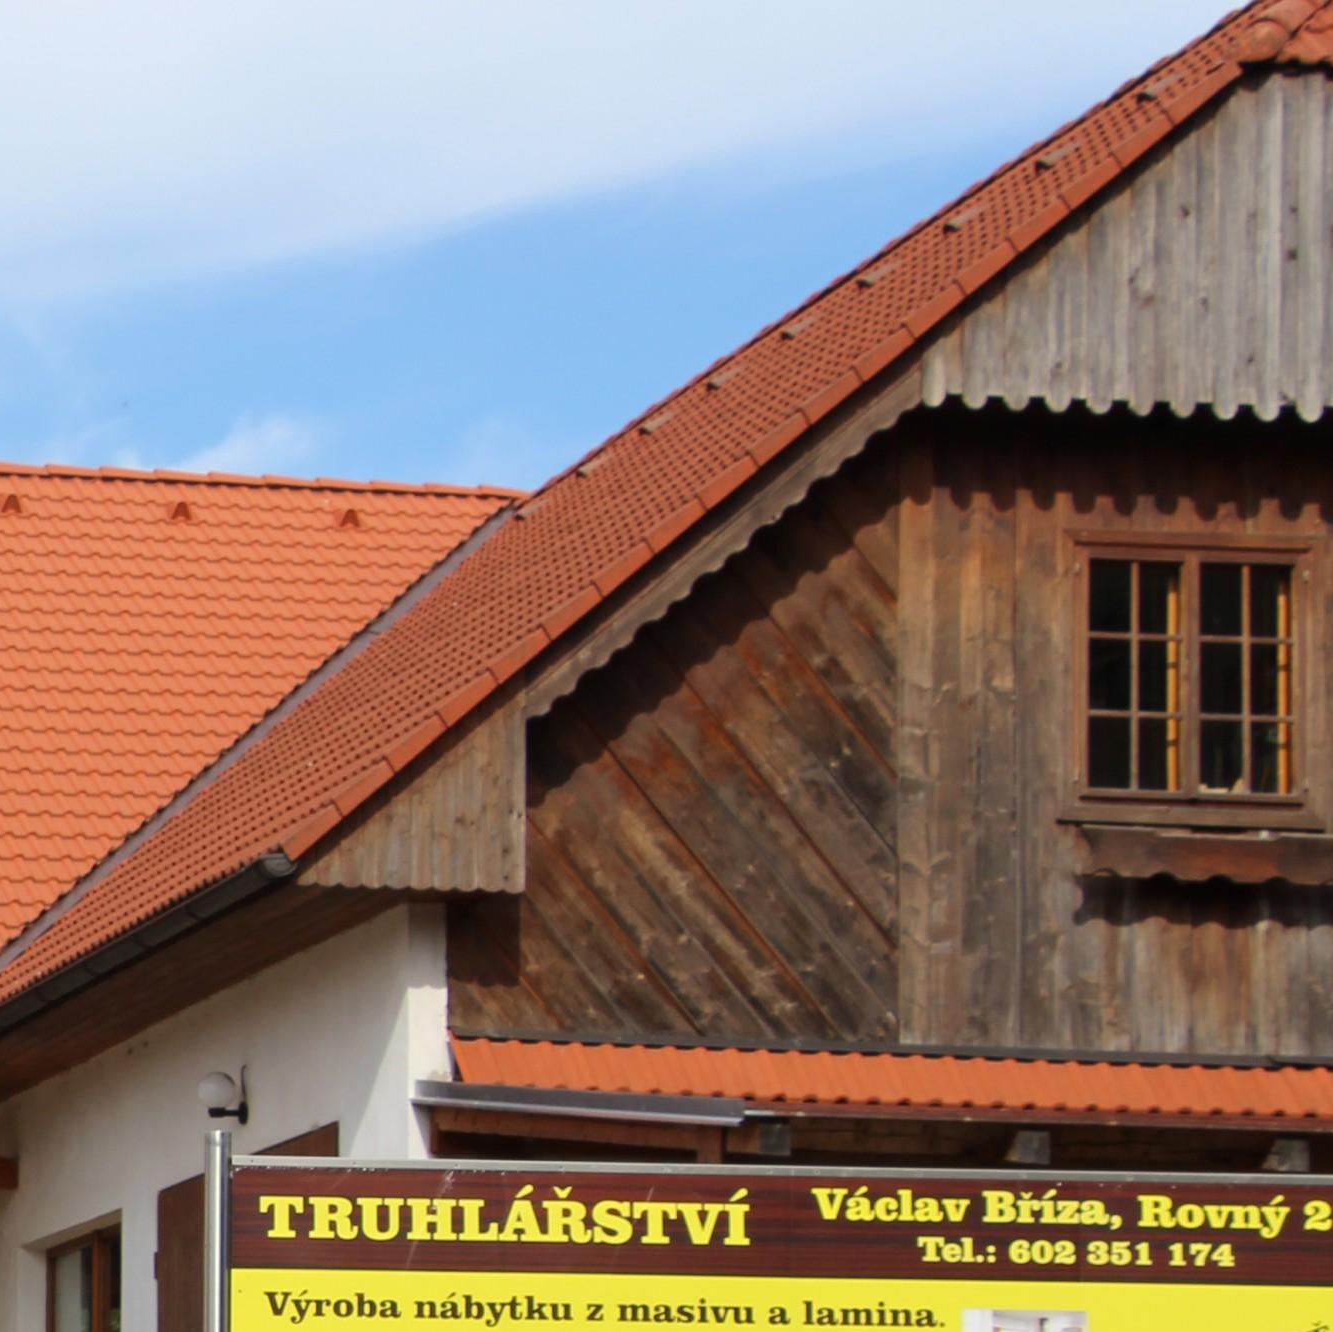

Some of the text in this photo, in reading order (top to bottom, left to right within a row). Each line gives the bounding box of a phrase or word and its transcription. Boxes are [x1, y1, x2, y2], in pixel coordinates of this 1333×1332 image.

[259, 1185, 751, 1246] TRUHLÁŘSTVÍ
[812, 1186, 970, 1224] Václav
[982, 1189, 1123, 1230] Bříza,
[1137, 1195, 1290, 1238] Rovný
[917, 1236, 1235, 1267] Tel.: 602 351 174
[264, 1290, 946, 1328] Výroba nábytku z masivu a lamina.
